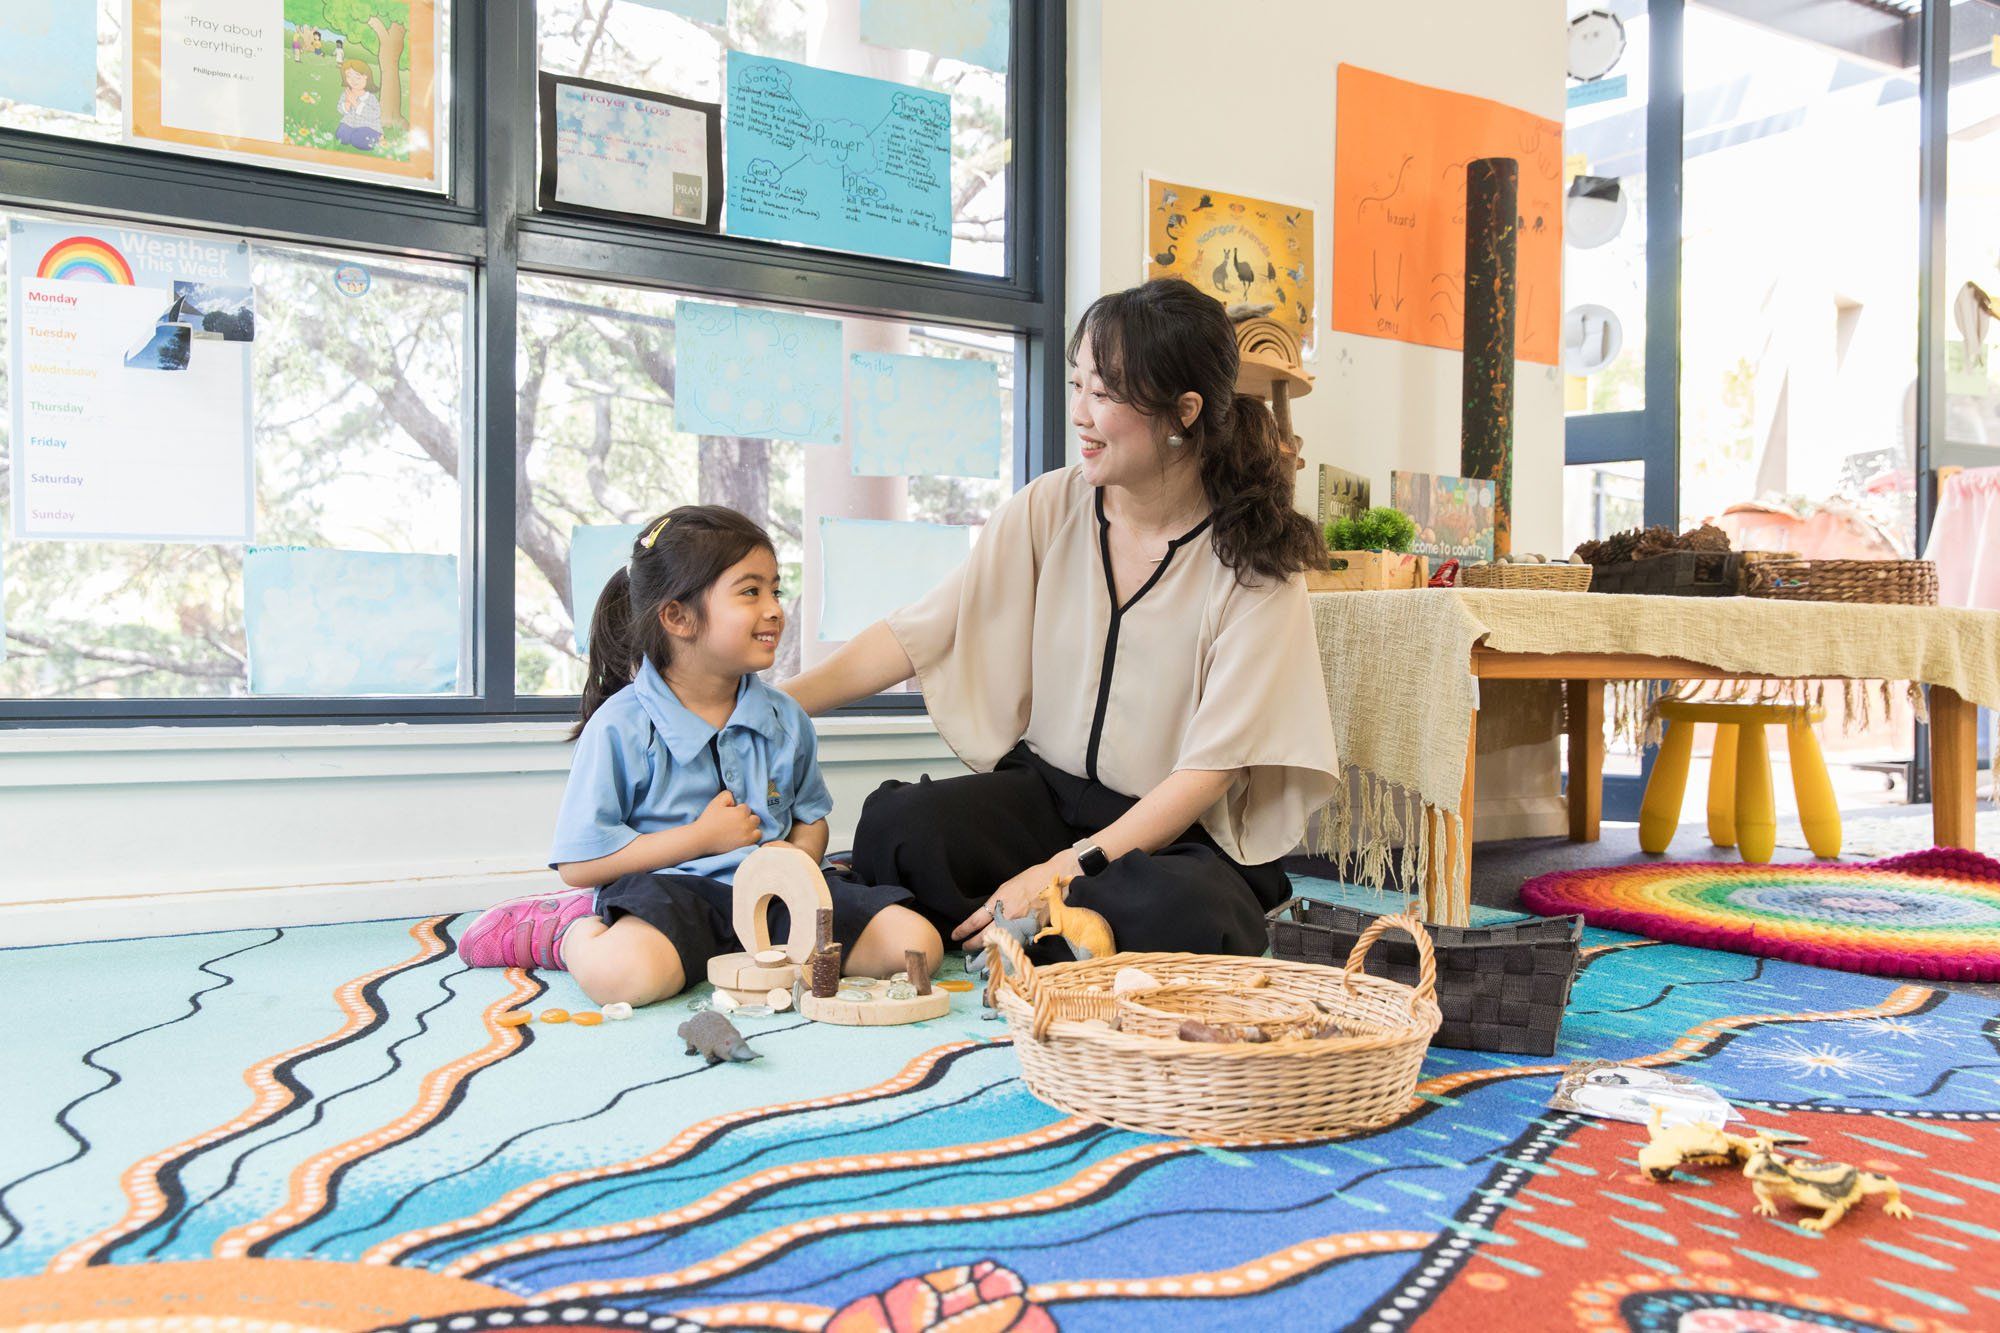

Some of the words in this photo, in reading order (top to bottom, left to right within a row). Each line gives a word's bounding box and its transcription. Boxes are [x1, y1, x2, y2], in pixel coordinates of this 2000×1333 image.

[223, 21, 263, 39] about
[582, 92, 625, 109] Prayer
[814, 124, 865, 162] Prayer
[675, 184, 701, 197] PRAY
[848, 176, 879, 197] Please
[1387, 208, 1416, 228] lizard
[119, 231, 231, 264] Weather
[137, 254, 173, 274] This
[179, 259, 229, 279] Week
[29, 291, 78, 306] Monday
[29, 326, 77, 341] Tuesday
[1377, 318, 1399, 334] emu
[29, 363, 97, 379] Wednesday
[30, 401, 84, 415] Thursday
[30, 436, 67, 450] Friday
[31, 473, 84, 487] Saturday
[31, 509, 75, 522] Sunday
[1411, 539, 1439, 554] lcome
[1440, 540, 1450, 555] to
[1452, 543, 1487, 559] country
